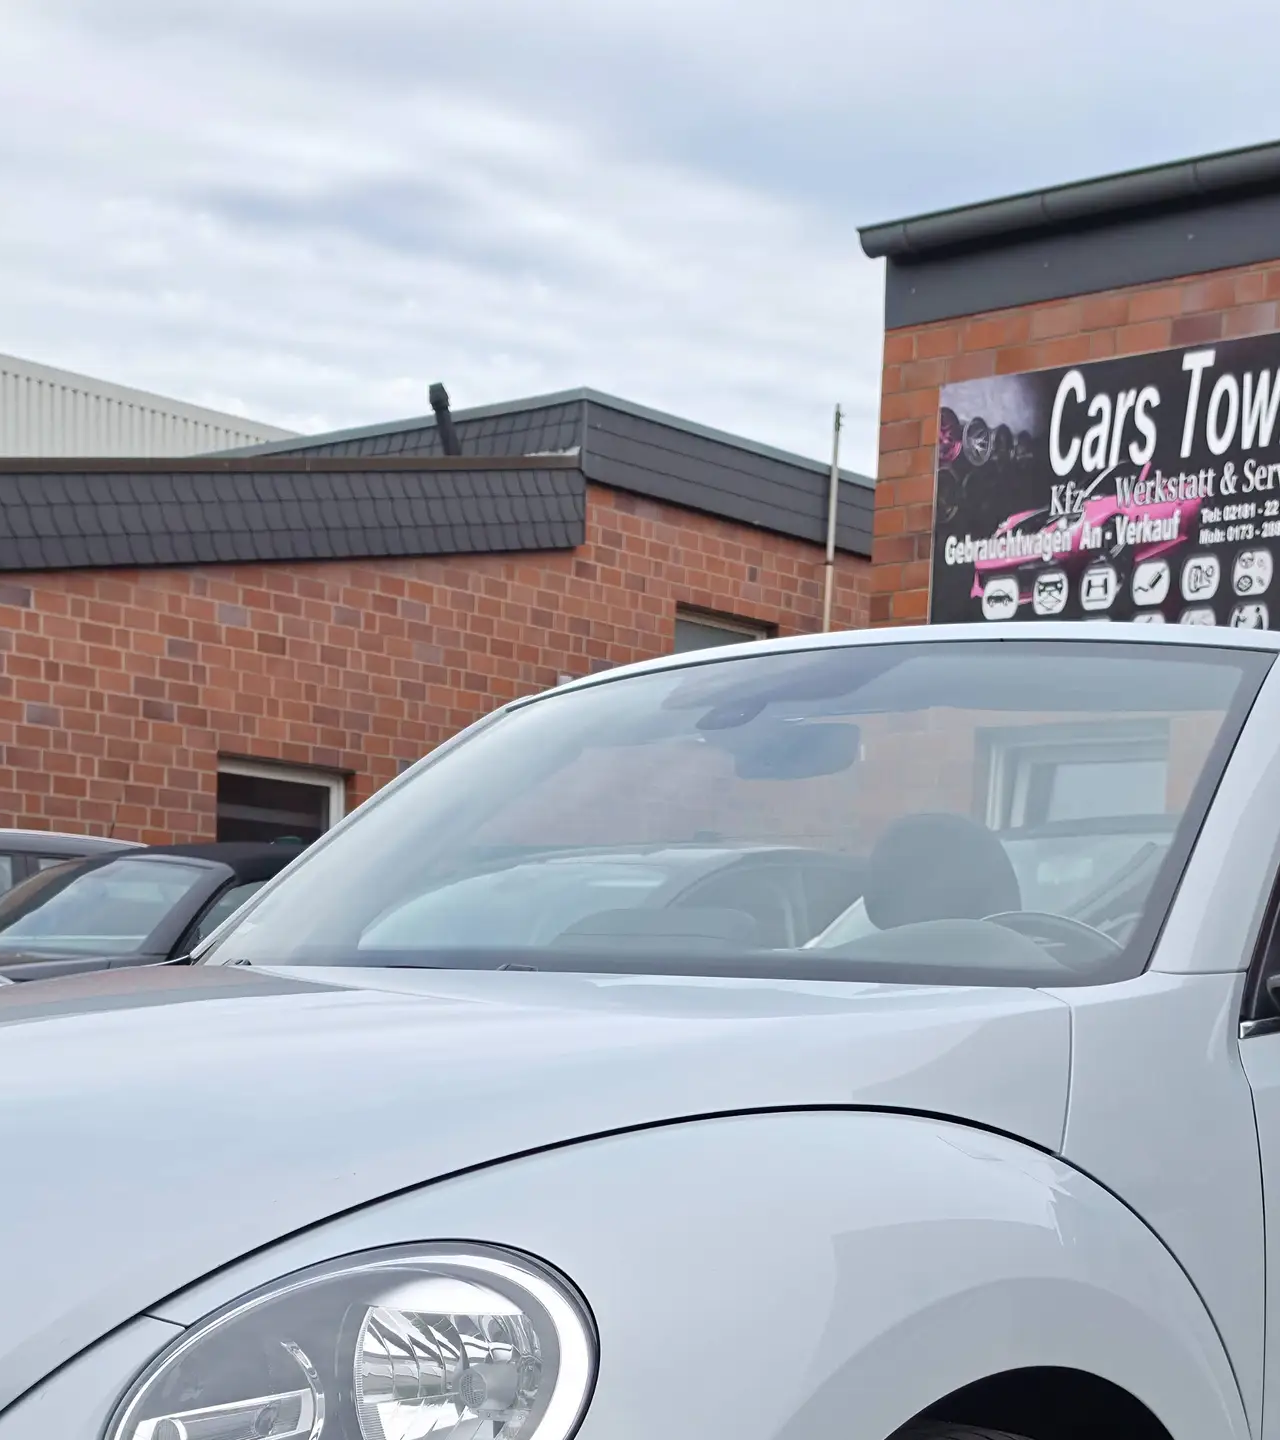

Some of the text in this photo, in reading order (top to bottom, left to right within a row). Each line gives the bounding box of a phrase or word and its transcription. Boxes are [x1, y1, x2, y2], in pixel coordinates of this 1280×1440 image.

[1049, 369, 1161, 477] Cars
[1049, 482, 1085, 517] Kfz
[1116, 467, 1217, 508] Werkstatt
[1220, 462, 1237, 497] &
[945, 528, 1073, 566] Gebrauchtwagen
[1080, 523, 1102, 550] An
[1116, 509, 1181, 546] Verkauf
